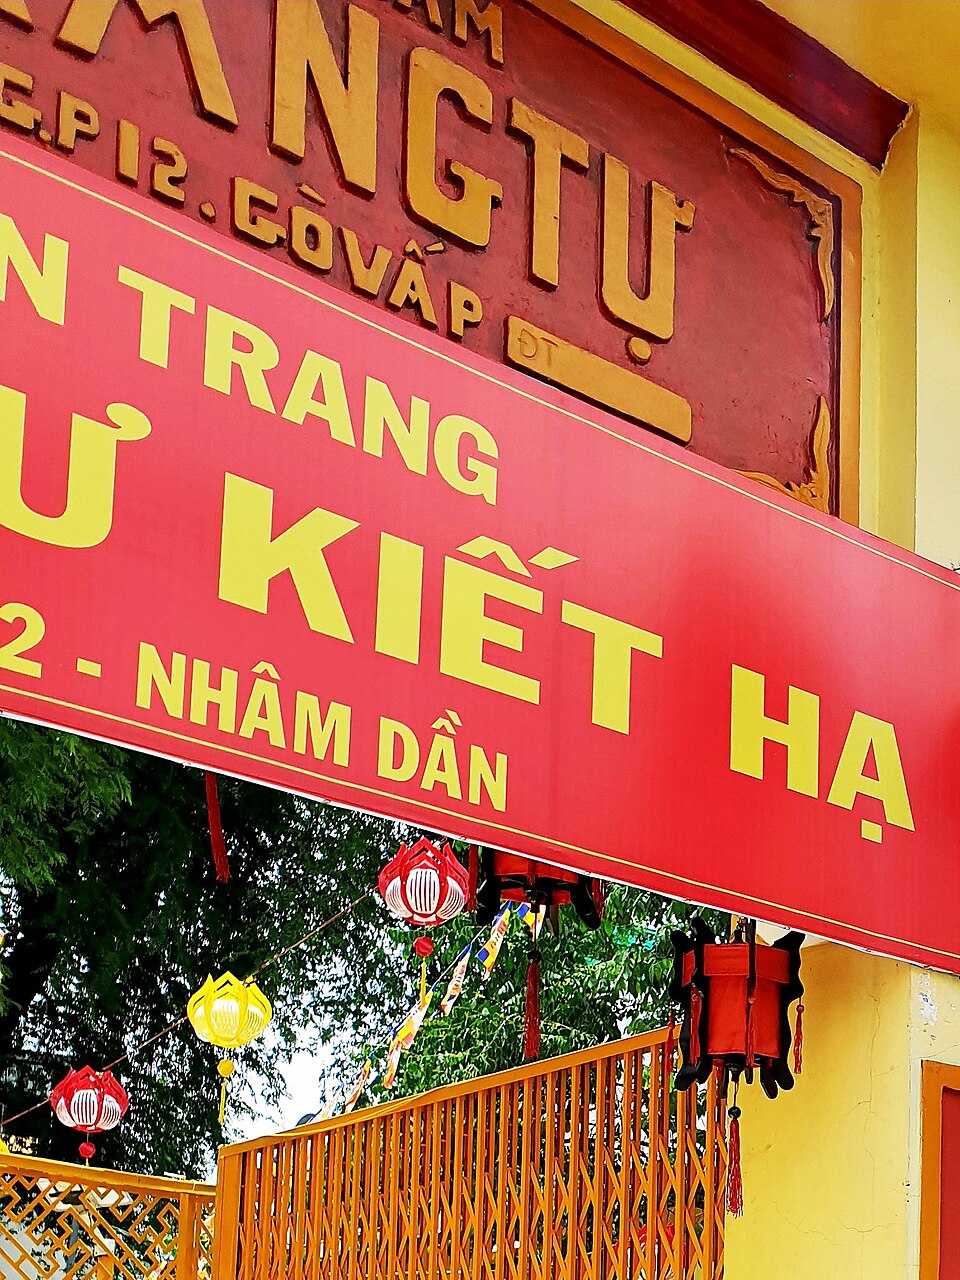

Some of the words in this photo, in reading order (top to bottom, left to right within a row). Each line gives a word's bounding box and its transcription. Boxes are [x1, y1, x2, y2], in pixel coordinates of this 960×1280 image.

[117, 265, 501, 506] TRANG
[136, 640, 351, 768] NHÂM
[377, 709, 509, 812] DẦN
[218, 471, 663, 735] KIẾT
[730, 663, 915, 844] HẠ
